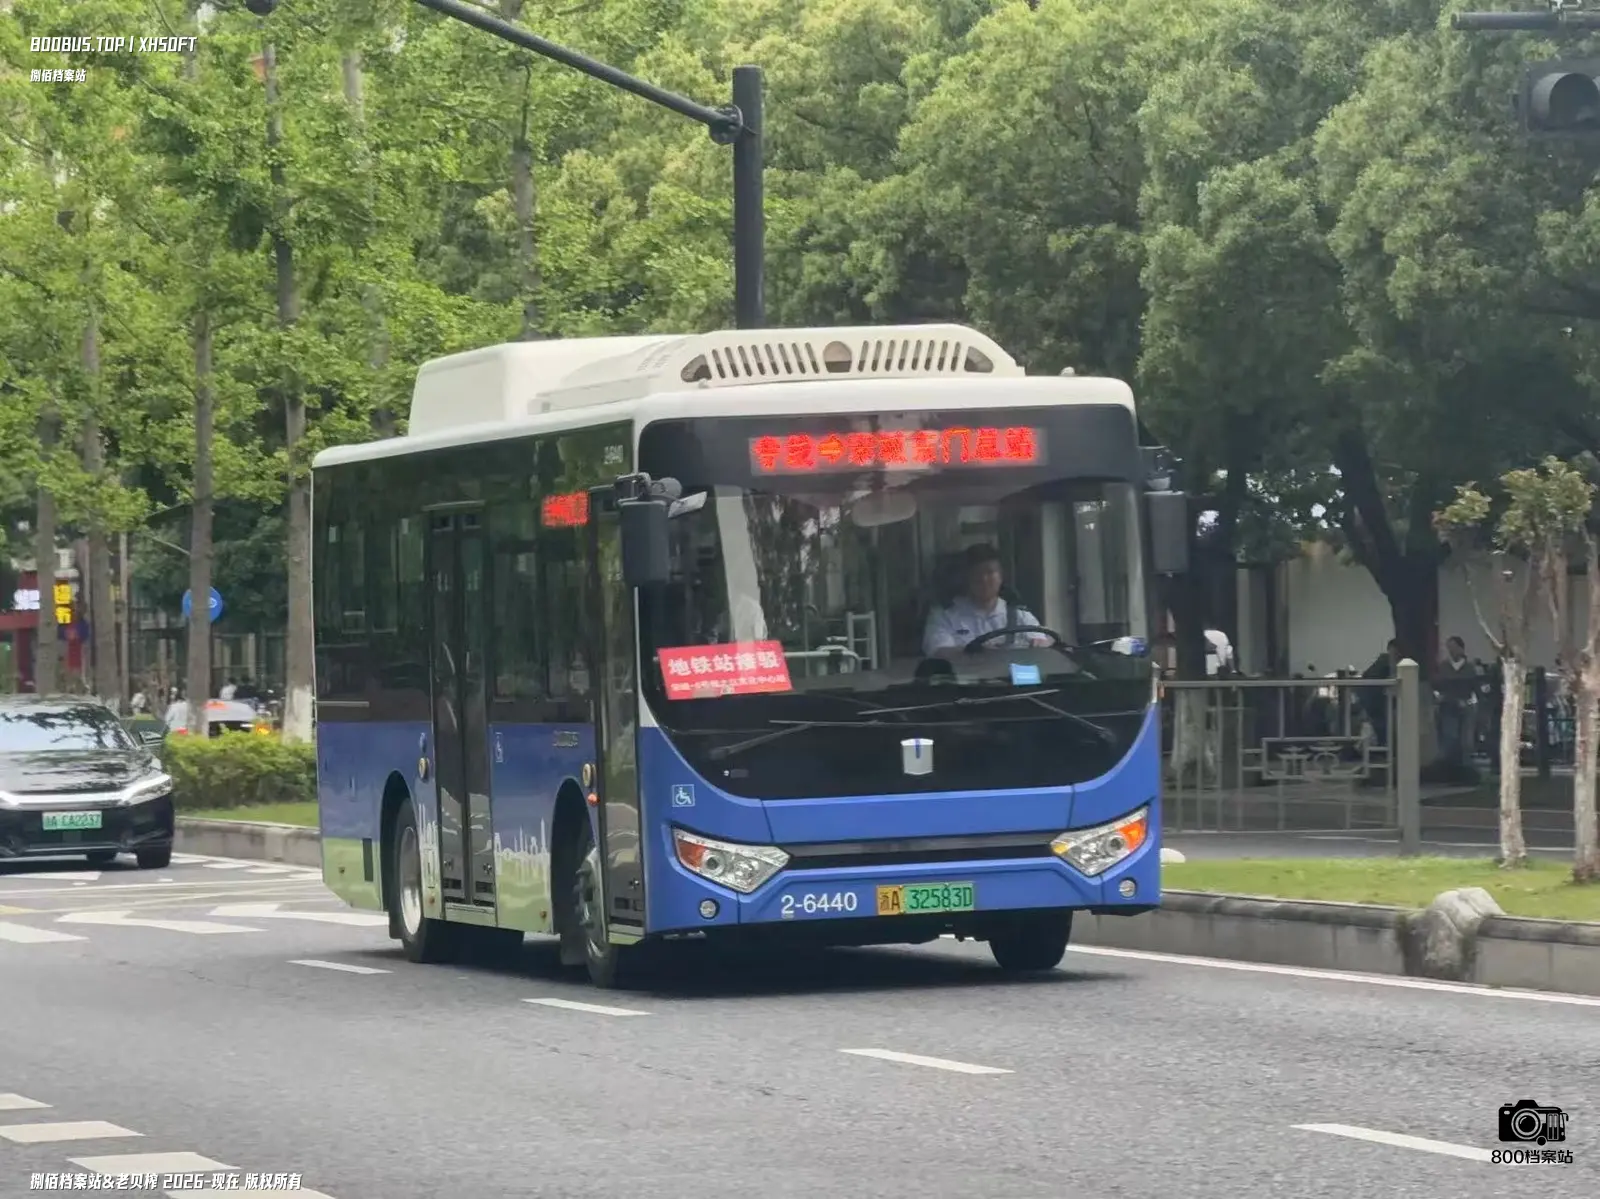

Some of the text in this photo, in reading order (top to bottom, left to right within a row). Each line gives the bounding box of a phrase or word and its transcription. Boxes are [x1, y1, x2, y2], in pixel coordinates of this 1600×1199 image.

[668, 651, 781, 676] 地铁站接驳
[780, 892, 858, 914] 2-6440
[909, 886, 973, 910] 32583D
